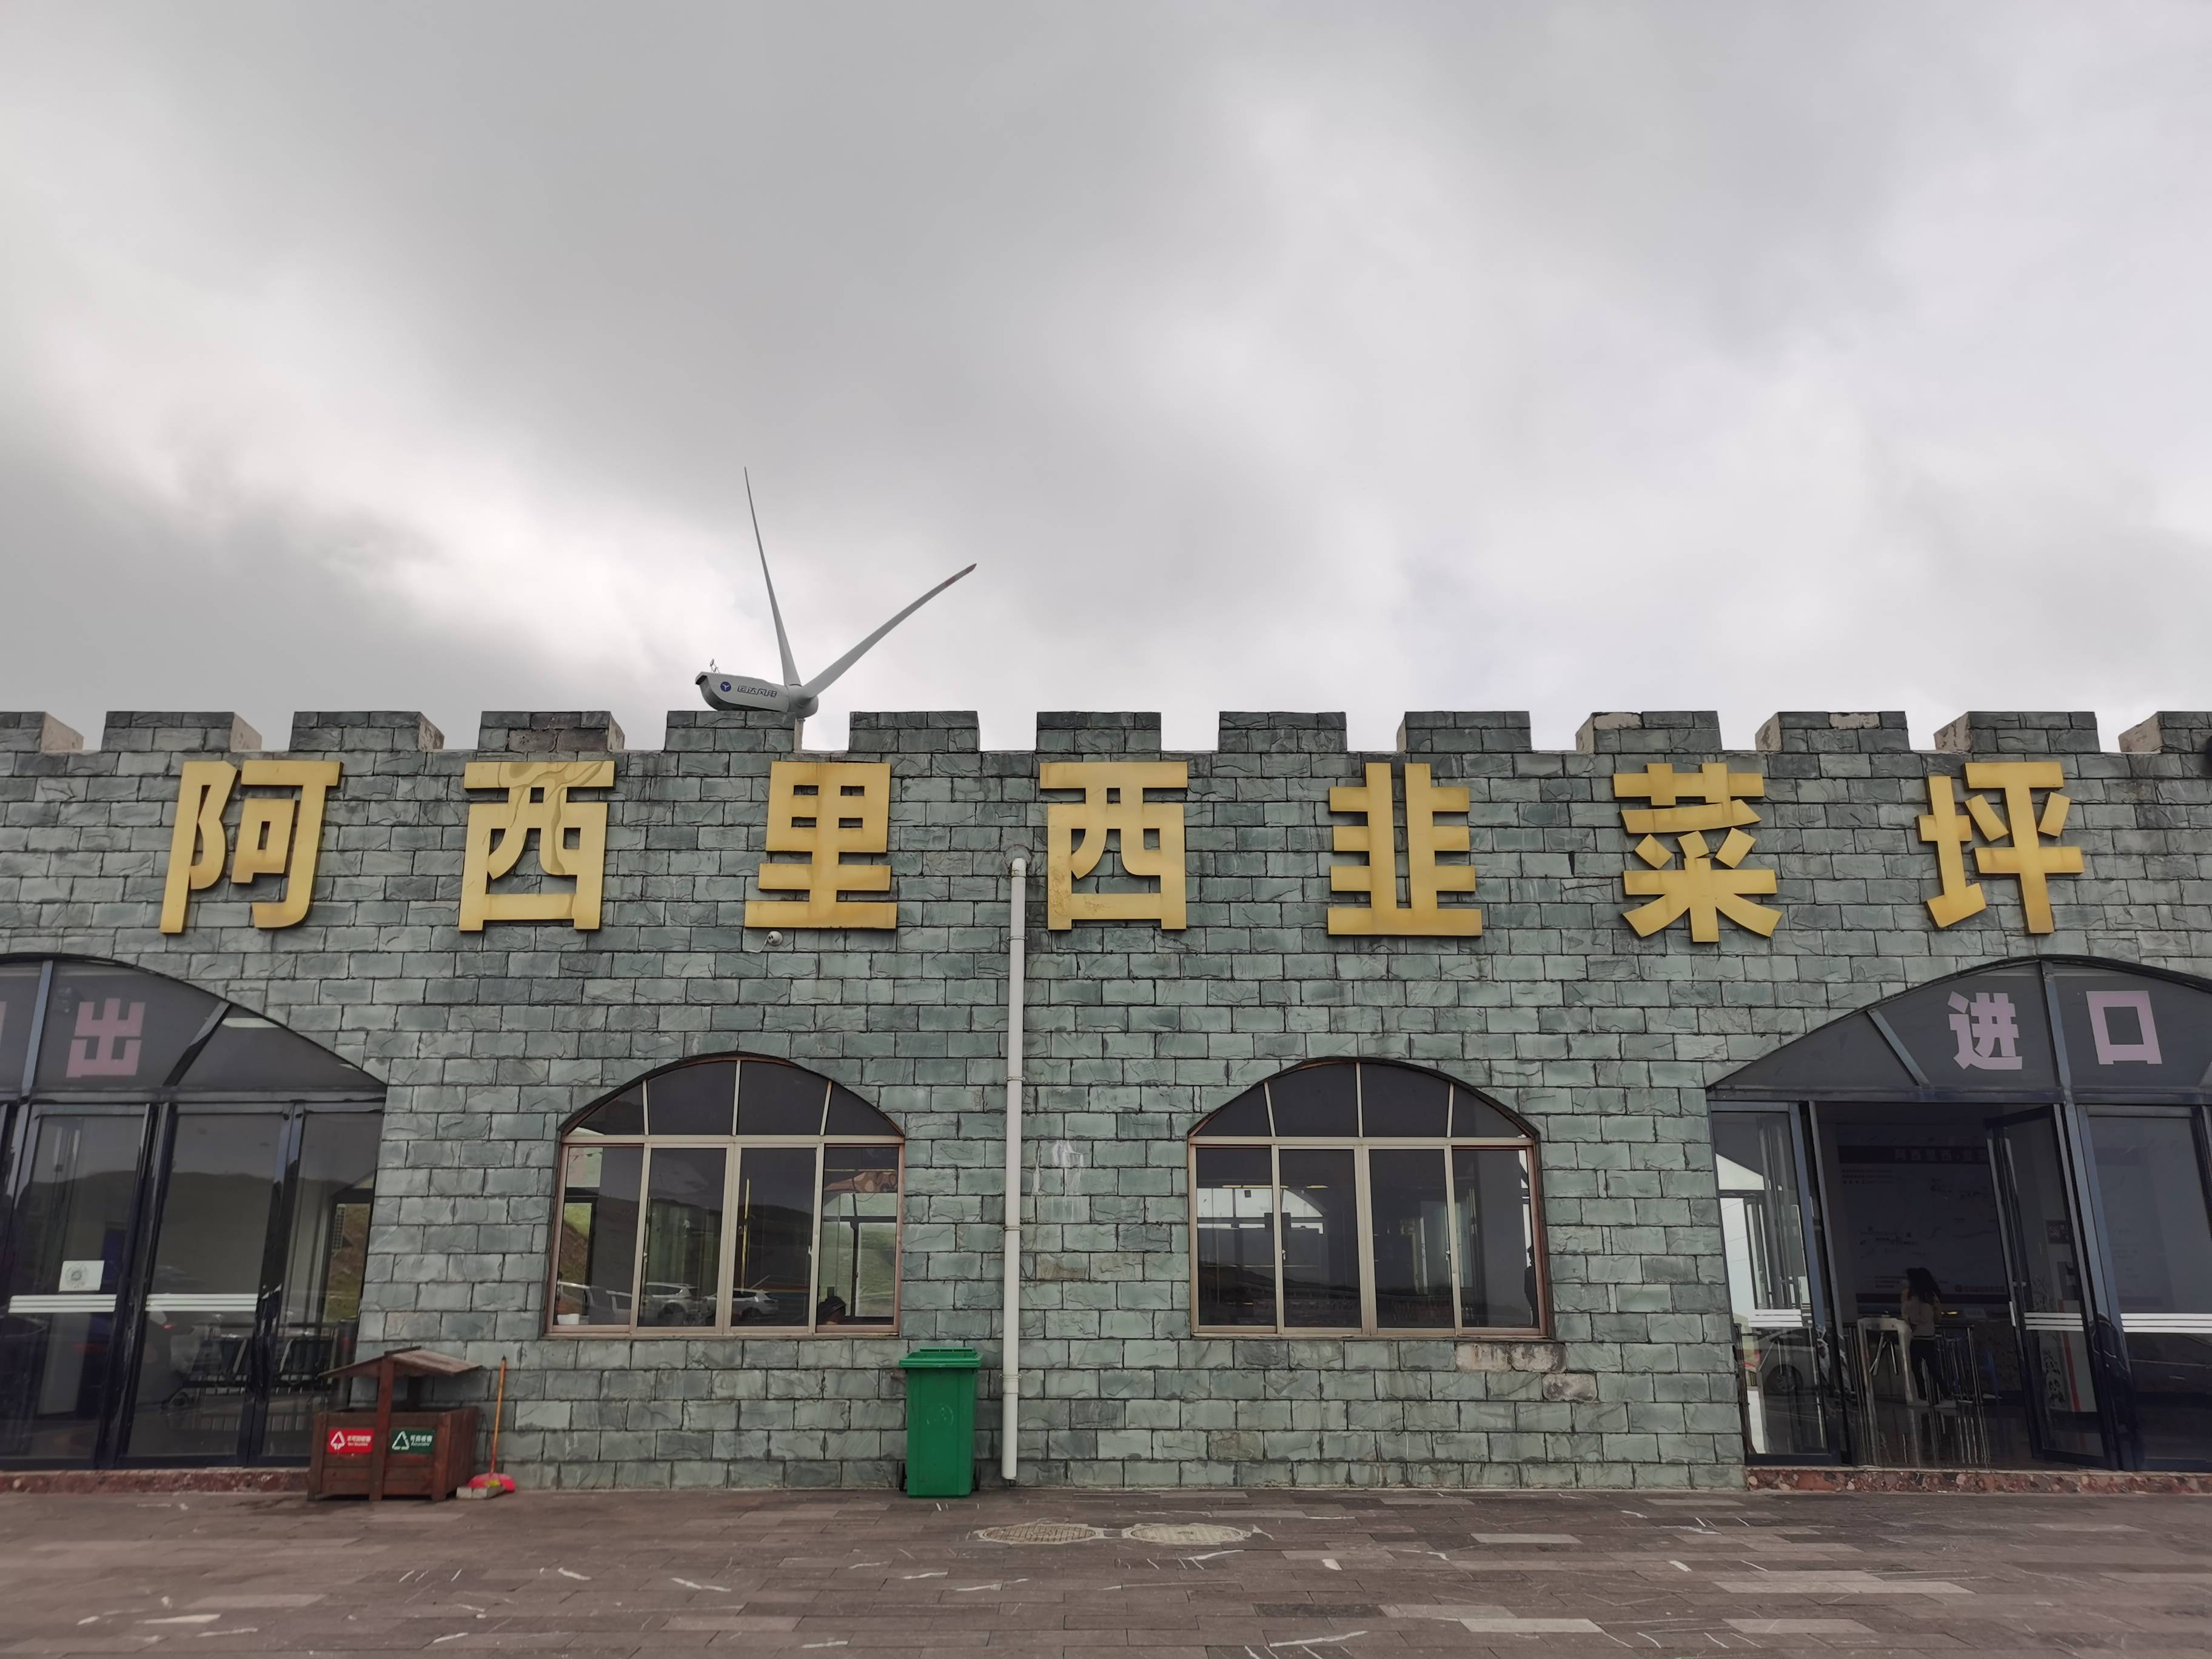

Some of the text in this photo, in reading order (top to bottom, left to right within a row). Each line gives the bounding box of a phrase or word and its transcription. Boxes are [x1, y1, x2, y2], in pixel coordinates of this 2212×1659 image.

[159, 760, 2085, 943] 阿西里西韭菜坪
[1947, 990, 2162, 1070] 进口
